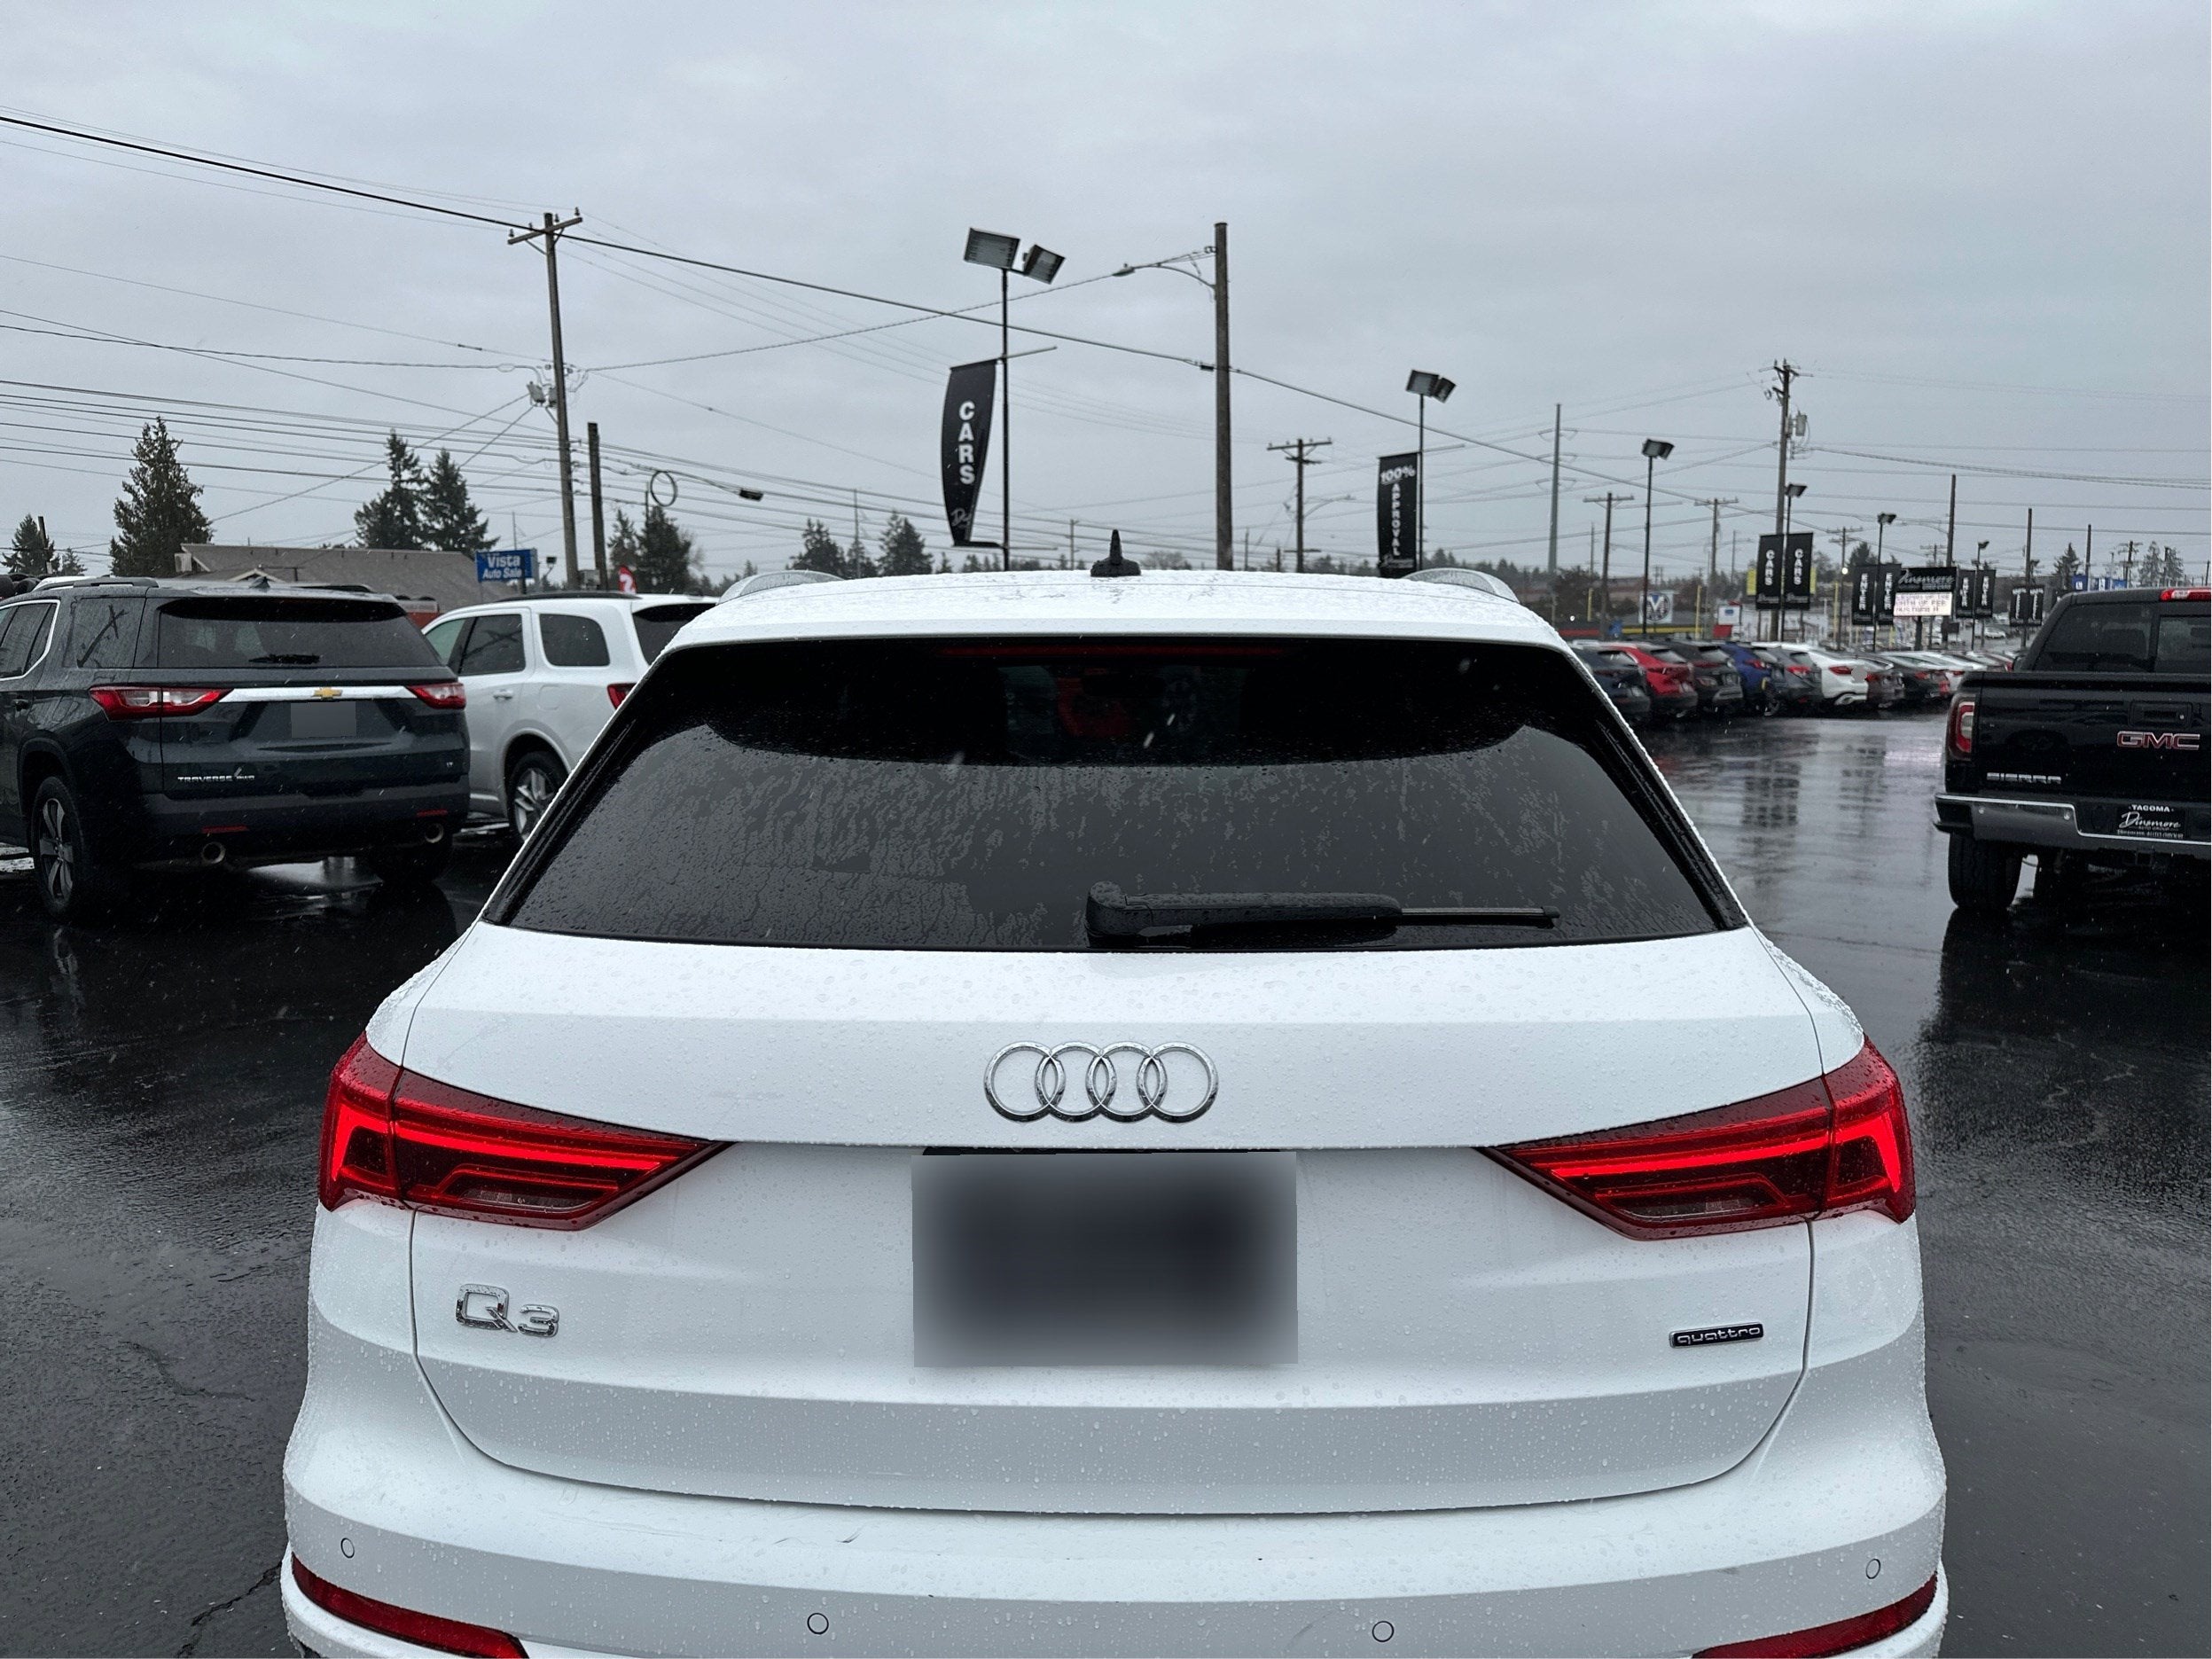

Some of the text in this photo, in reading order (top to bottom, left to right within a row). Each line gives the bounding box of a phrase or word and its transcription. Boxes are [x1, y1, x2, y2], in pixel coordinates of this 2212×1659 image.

[958, 401, 975, 484] CARS
[1380, 466, 1416, 484] 100%
[1392, 483, 1401, 556] APPROVAL
[488, 553, 520, 567] Vista
[1765, 550, 1775, 585] CARS
[1794, 548, 1804, 584] CARS
[482, 568, 502, 579] Auto
[1859, 573, 1868, 610] ENTER
[2117, 731, 2200, 750] GMC
[1987, 772, 2061, 784] SIERRA
[2131, 804, 2170, 813] TACOMA
[2119, 811, 2181, 828] Dinsmore
[456, 1284, 559, 1337] Q3
[1677, 1327, 1760, 1344] quattro
